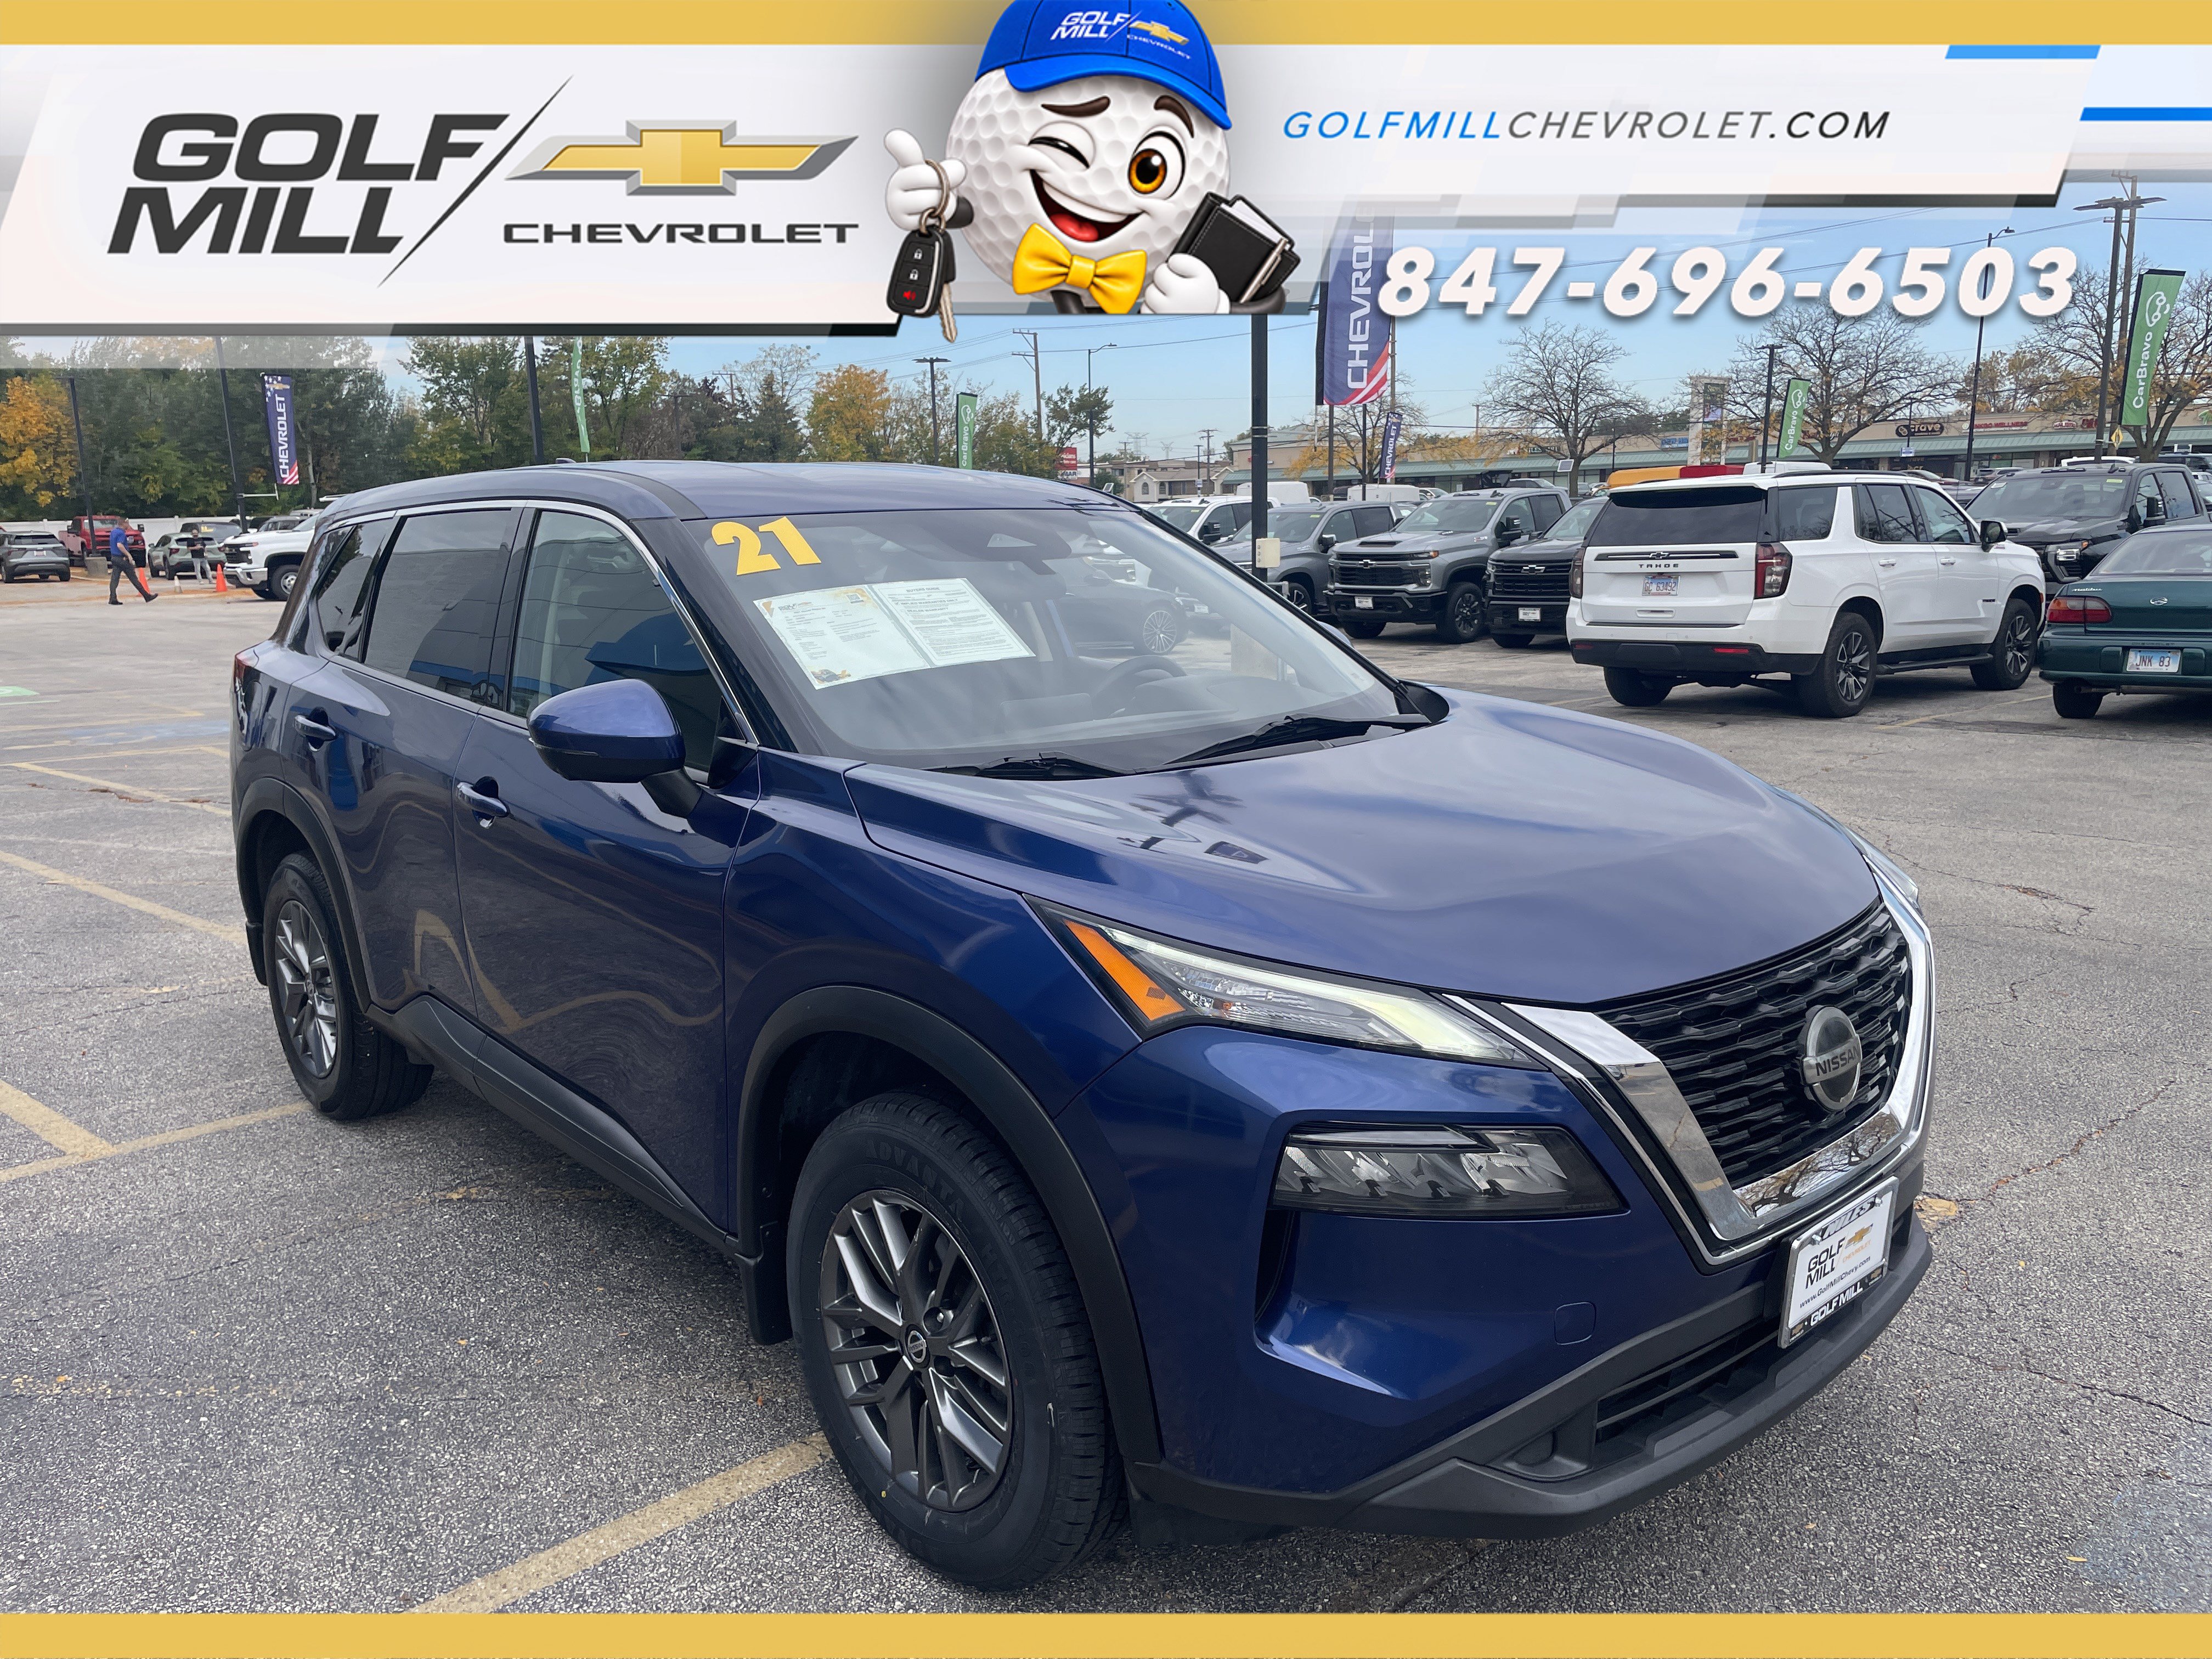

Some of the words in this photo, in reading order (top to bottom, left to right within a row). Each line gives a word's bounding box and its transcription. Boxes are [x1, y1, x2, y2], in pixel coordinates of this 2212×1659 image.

[1347, 207, 1374, 389] CHEVROL
[2132, 331, 2153, 408] CarBravo
[275, 393, 290, 478] CHEVROLET
[1385, 425, 1397, 475] CHEVROLET
[1785, 410, 1798, 450] CarBravo
[711, 516, 821, 575] 21
[1656, 582, 1677, 591] 63492
[2136, 656, 2153, 667] JNK
[2159, 656, 2171, 667] 83
[1815, 1046, 1859, 1076] NISSAN
[865, 1138, 966, 1222] ADVANTA
[1805, 1259, 1835, 1289] MILL
[1808, 1237, 1846, 1273] GOLF
[1799, 1256, 1871, 1309] www.GolfMillChevy.com
[1810, 1296, 1839, 1327] GOLF
[1838, 1282, 1863, 1307] MILL
